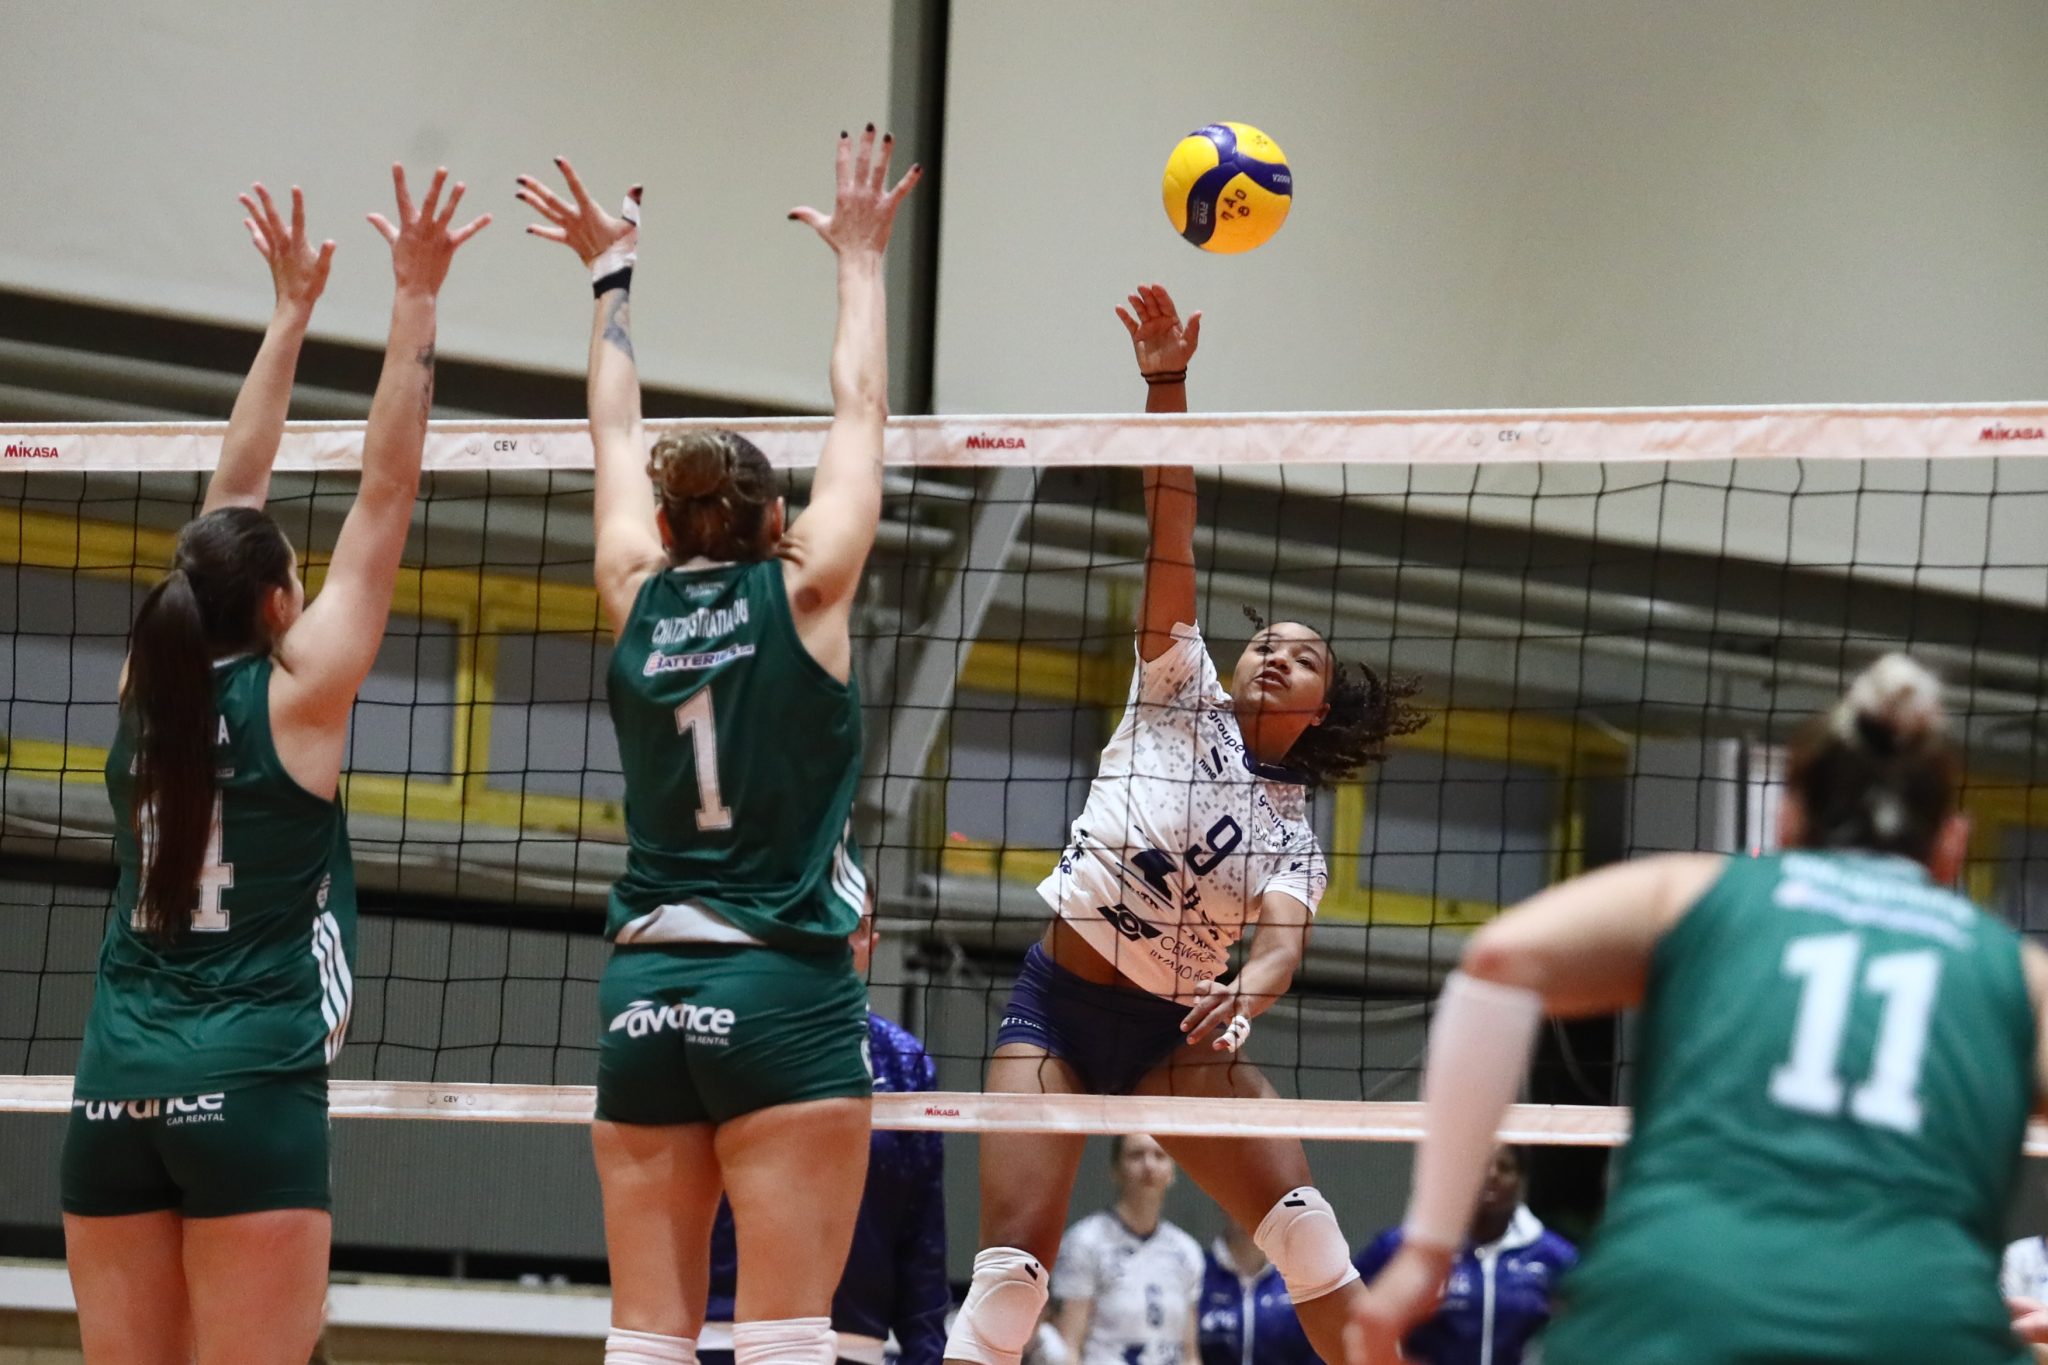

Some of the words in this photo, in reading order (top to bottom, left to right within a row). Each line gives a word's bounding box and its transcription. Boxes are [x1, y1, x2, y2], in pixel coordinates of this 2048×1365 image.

[493, 439, 518, 452] CEV
[1498, 429, 1521, 442] CEV
[1207, 709, 1245, 753] groupe
[674, 684, 733, 831] 1
[1199, 758, 1218, 781] nine
[1185, 814, 1243, 877] 9
[1768, 929, 1943, 1138] 11
[443, 1095, 459, 1104] CEV
[166, 1117, 184, 1126] CAR
[185, 1113, 225, 1124] RENTAL
